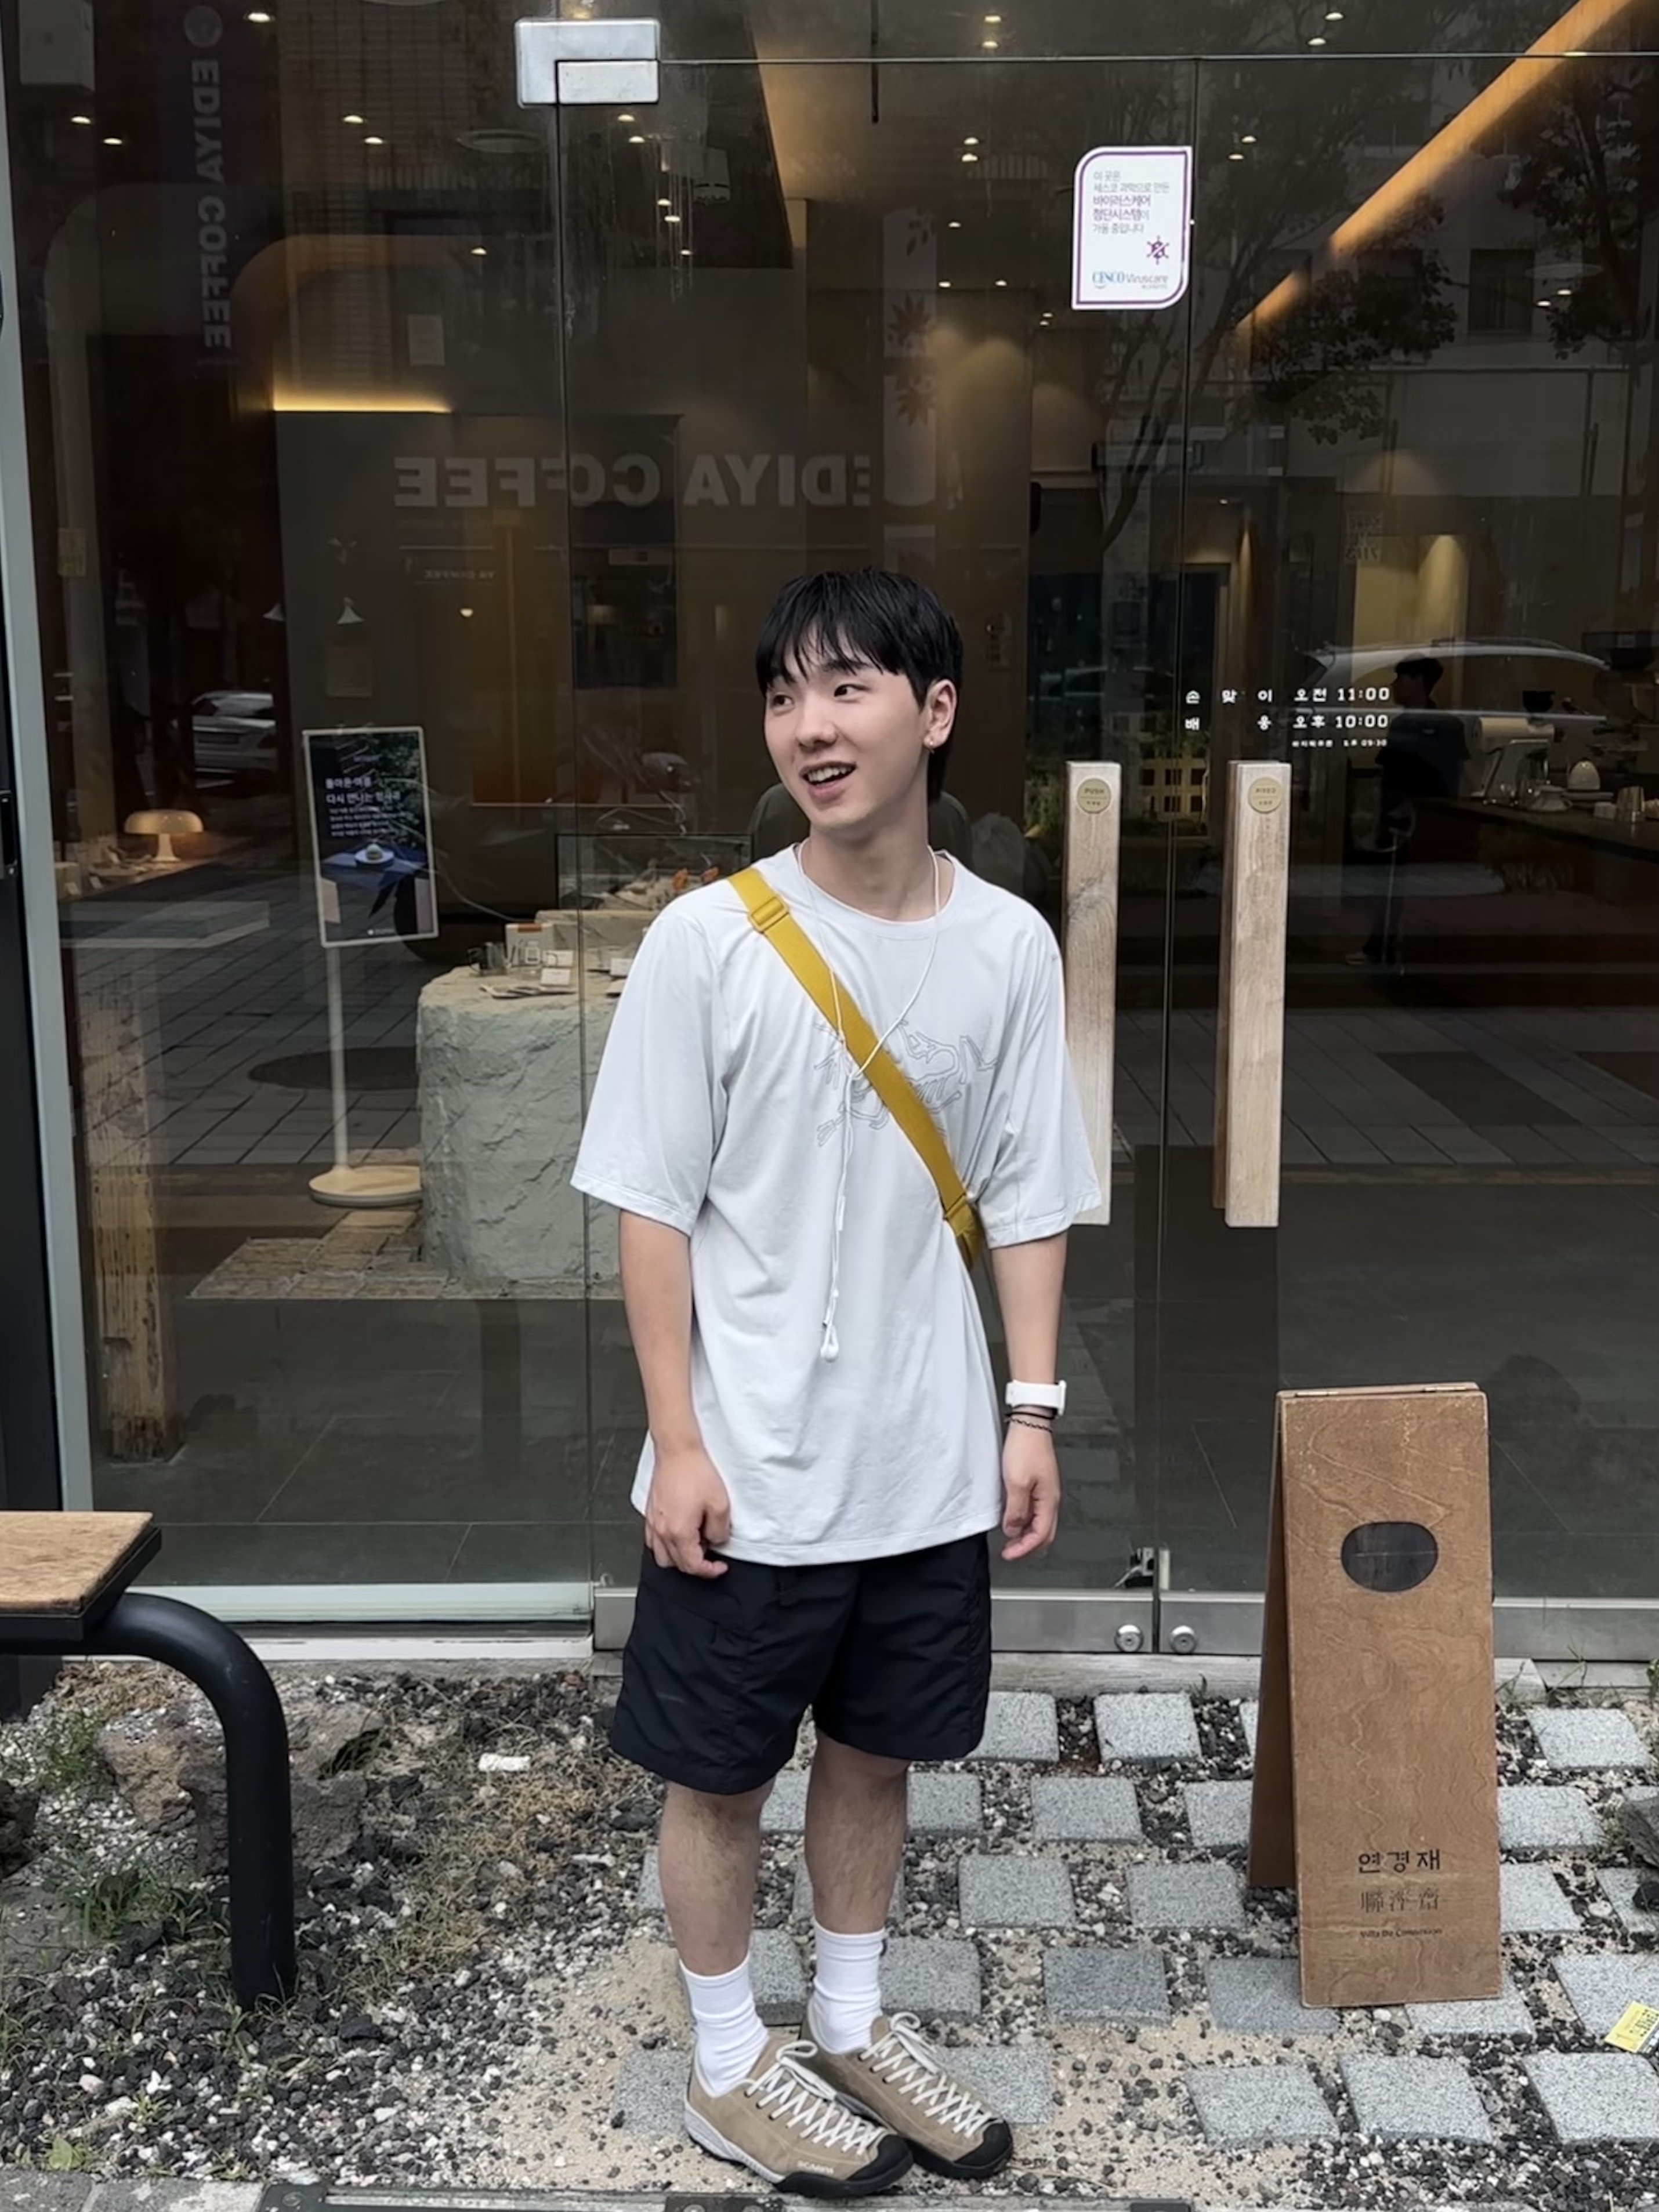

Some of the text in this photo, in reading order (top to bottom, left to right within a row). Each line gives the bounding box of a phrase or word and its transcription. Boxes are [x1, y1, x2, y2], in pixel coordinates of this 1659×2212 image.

[1093, 171, 1103, 181] 이
[1093, 194, 1151, 206] 바이러스케어
[1294, 688, 1327, 702] 오전
[1336, 687, 1390, 701] 11:00
[1292, 715, 1325, 729] 오후
[1335, 714, 1388, 728] 10:00
[1358, 1848, 1440, 1873] 연경재
